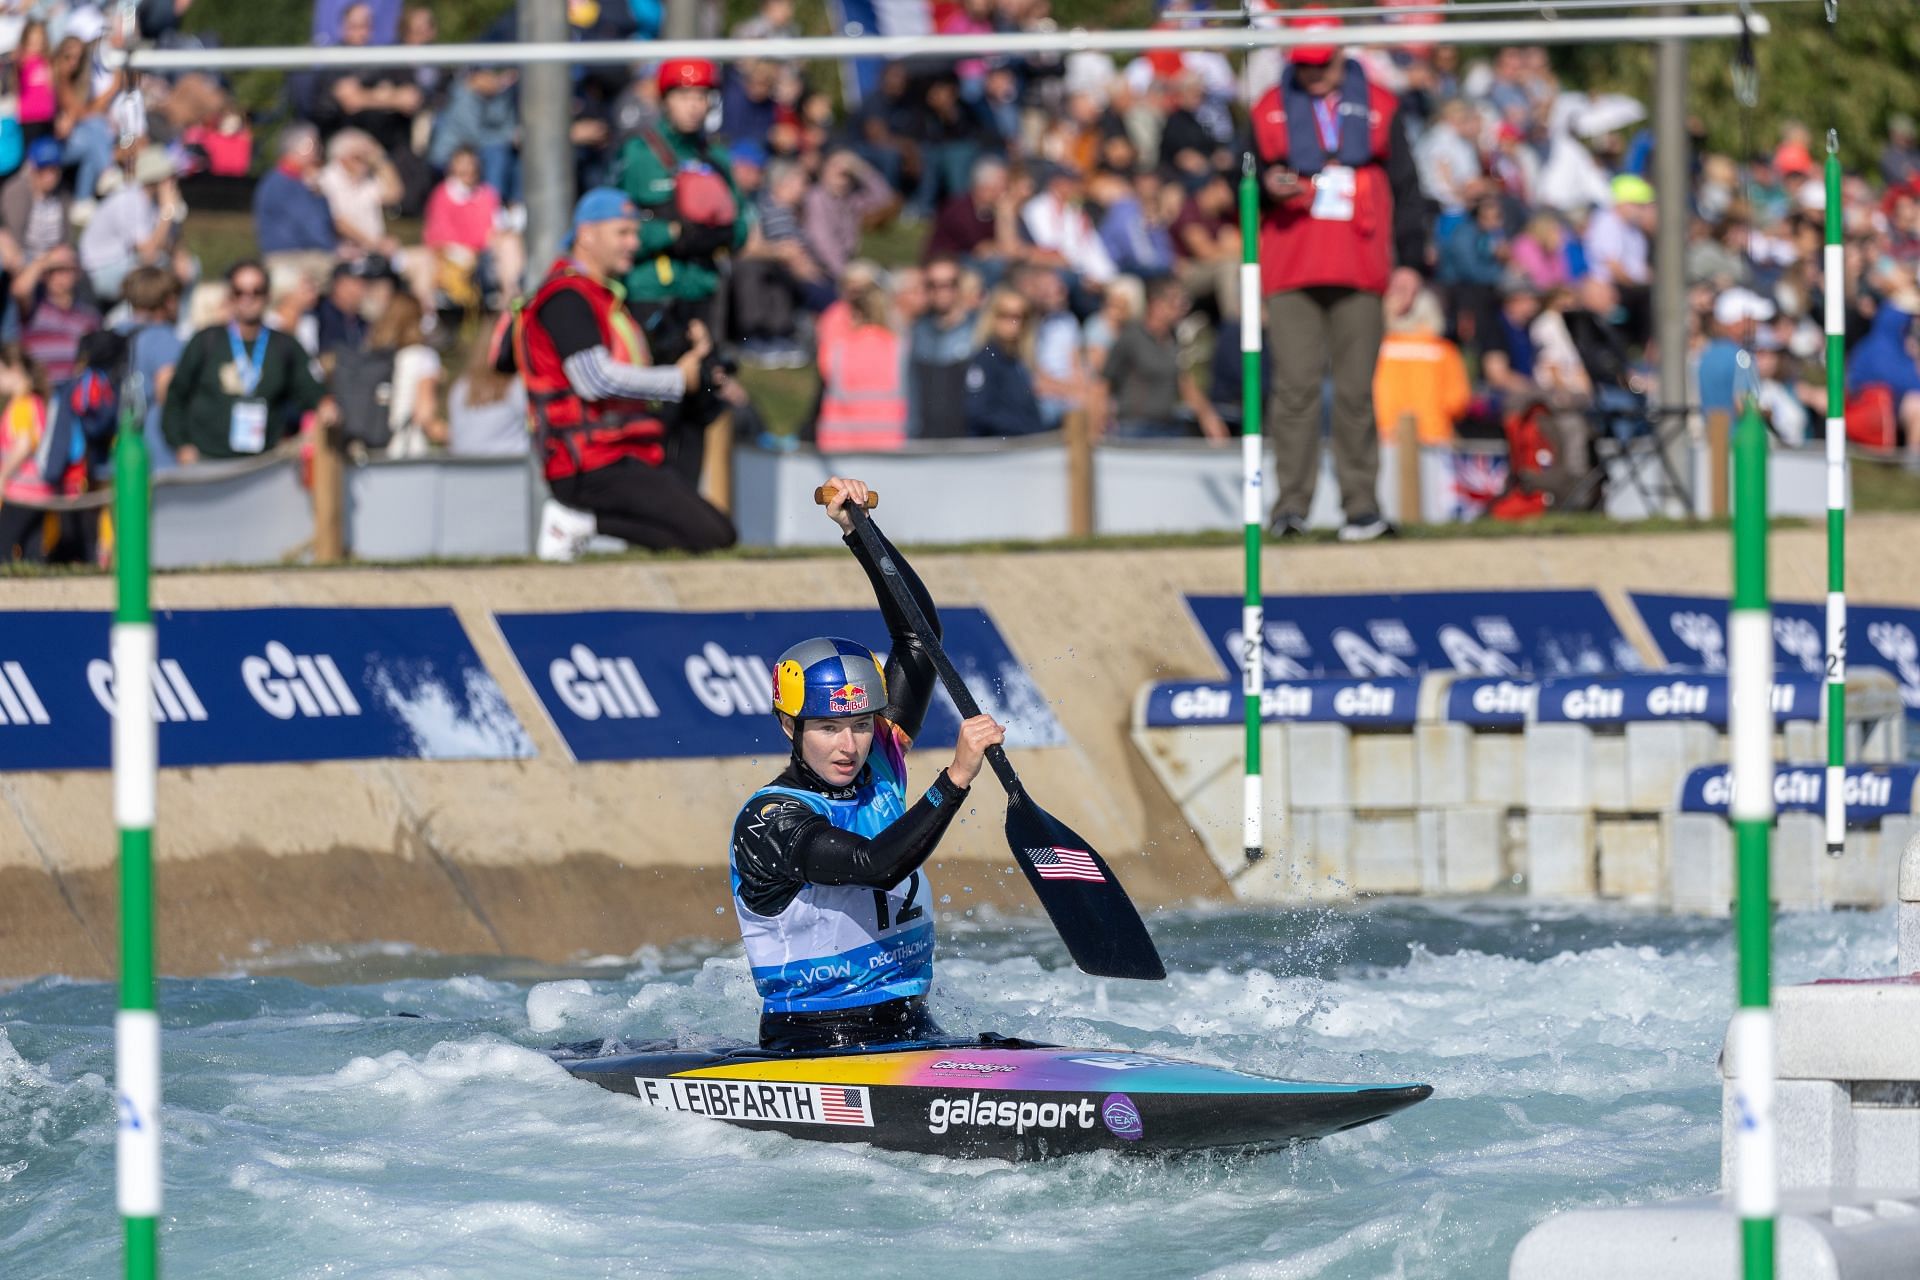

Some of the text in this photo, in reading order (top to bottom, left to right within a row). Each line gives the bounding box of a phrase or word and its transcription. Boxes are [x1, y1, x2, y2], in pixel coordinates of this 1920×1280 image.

[241, 640, 362, 720] Gill
[550, 643, 661, 720] Gill
[830, 695, 869, 712] Red Bull
[1171, 686, 1231, 719] Gill
[1333, 682, 1395, 717] Gill
[1562, 684, 1624, 720] Gill
[1646, 681, 1709, 715] Gill
[1773, 770, 1821, 804] Gill
[1843, 772, 1892, 807] Gill
[872, 871, 923, 931] 12
[800, 960, 850, 984] VOW
[670, 1083, 816, 1121] LEIBFARTH
[928, 1092, 1096, 1135] galasport
[1106, 1115, 1140, 1126] TEAM
